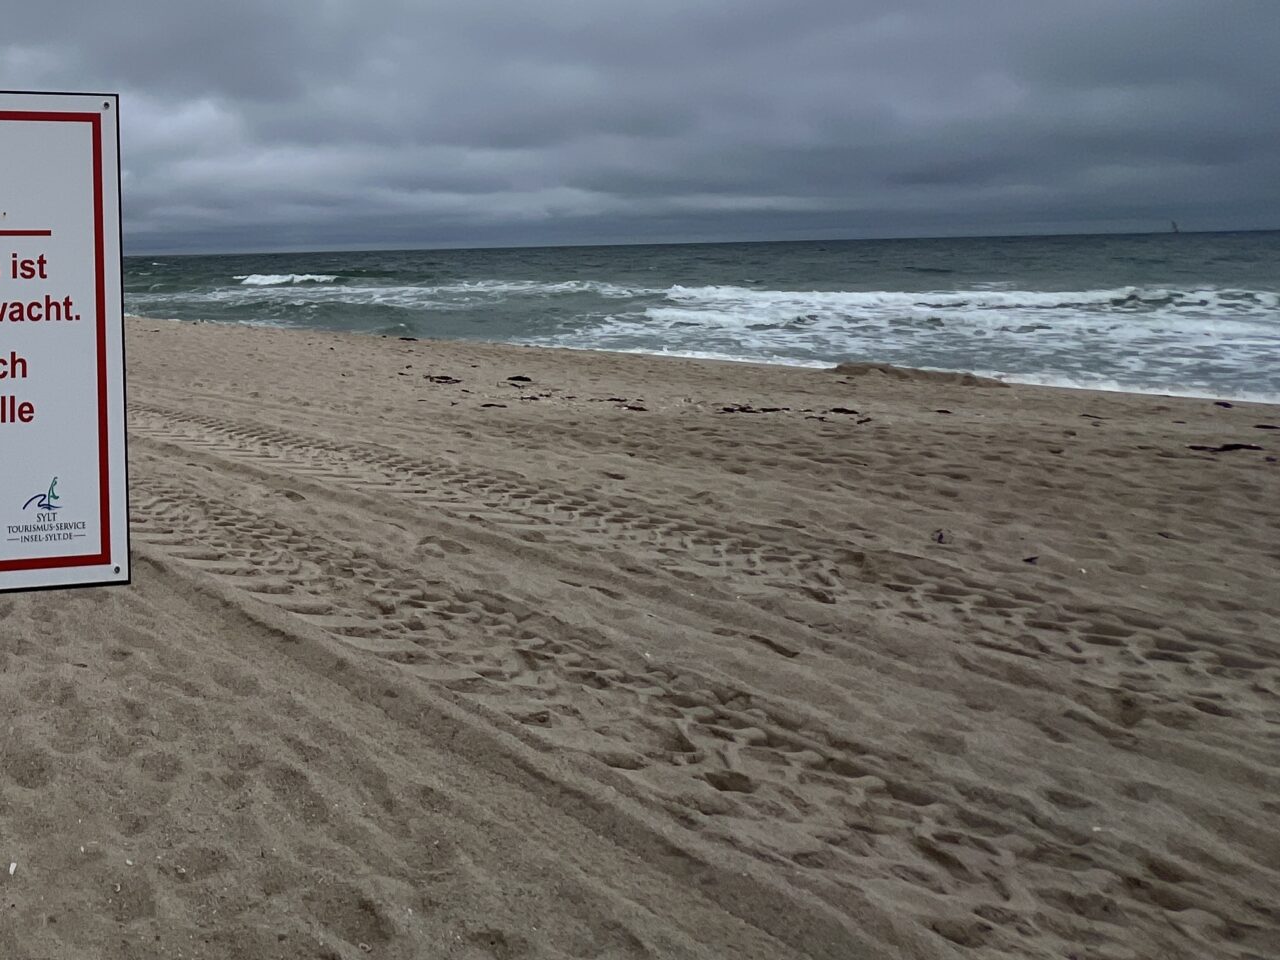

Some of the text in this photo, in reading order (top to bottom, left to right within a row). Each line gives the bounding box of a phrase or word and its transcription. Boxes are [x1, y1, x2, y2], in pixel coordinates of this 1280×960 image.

[12, 254, 47, 279] ist
[36, 512, 57, 522] SYLT
[7, 522, 86, 534] TOURISMUS-SERVICE
[20, 533, 73, 543] INSEL-SYLT.DE
